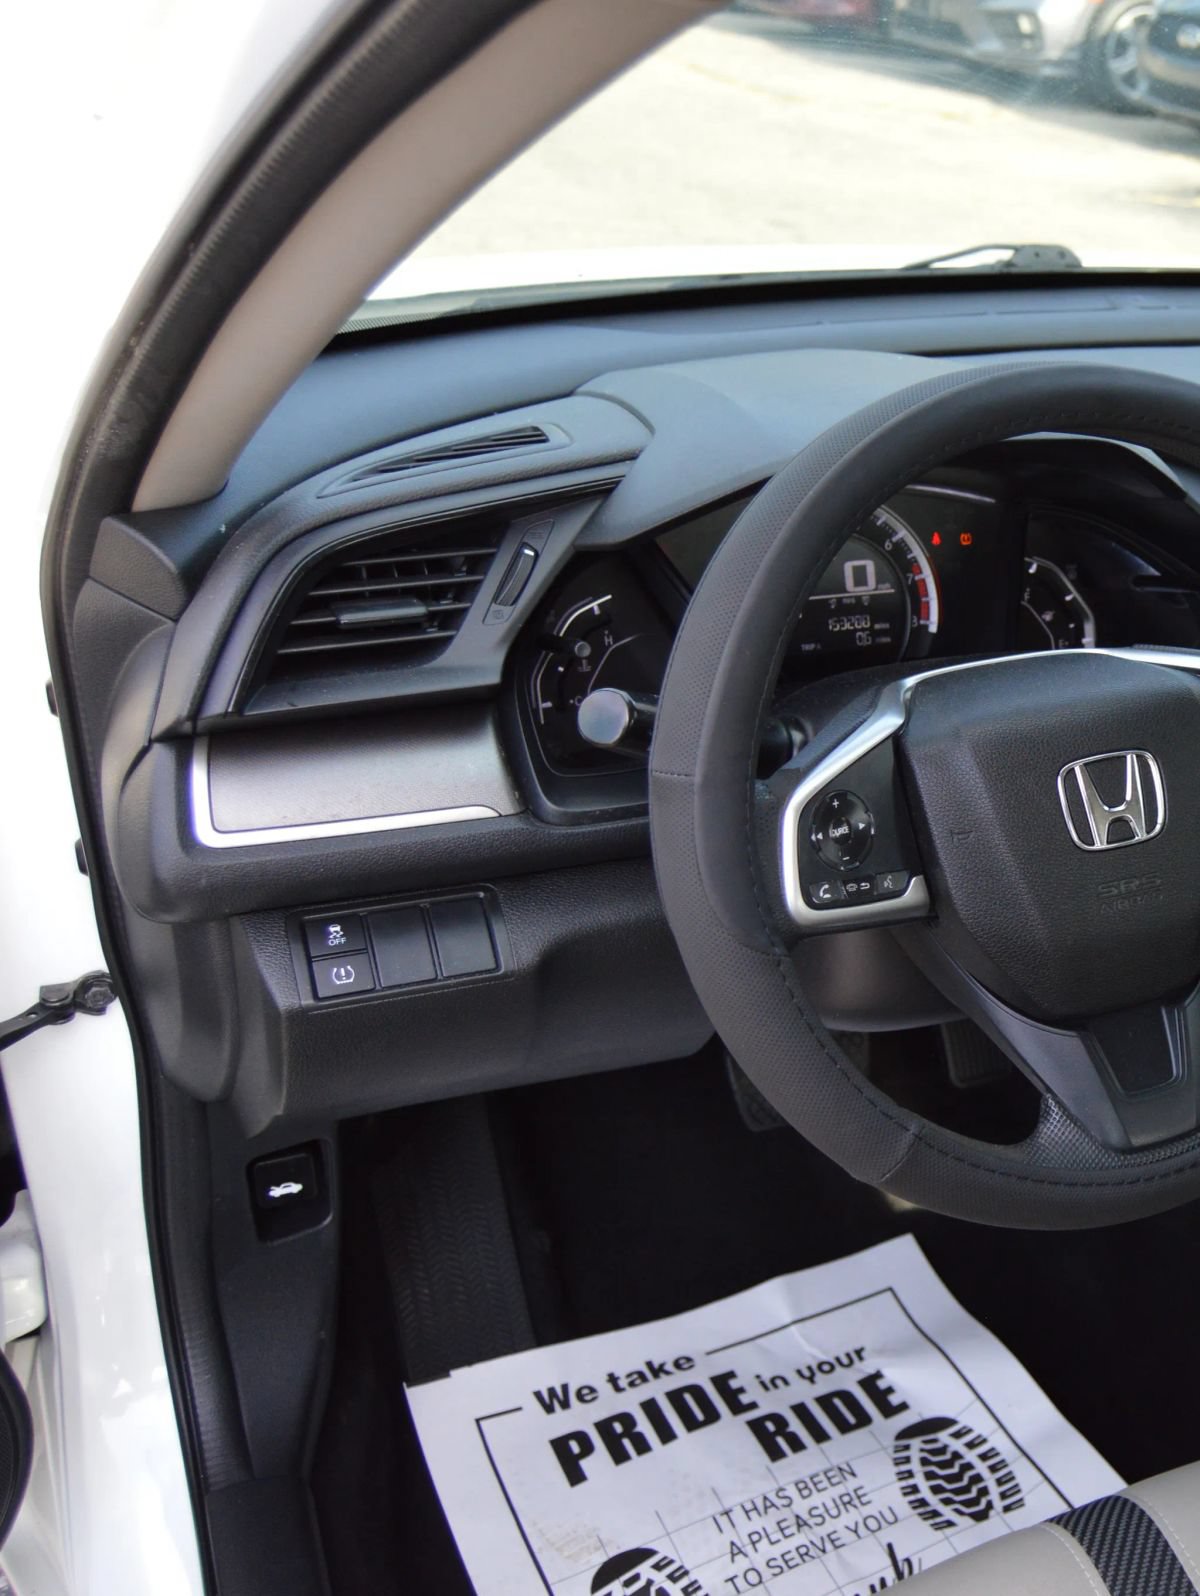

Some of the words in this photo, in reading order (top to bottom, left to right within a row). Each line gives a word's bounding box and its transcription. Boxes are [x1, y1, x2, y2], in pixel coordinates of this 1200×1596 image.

[844, 559, 876, 592] 0
[884, 540, 893, 551] 6
[328, 936, 347, 947] OFF
[532, 1382, 599, 1415] We
[606, 1354, 695, 1393] take
[549, 1370, 759, 1488] PRIDE
[755, 1373, 790, 1392] in
[795, 1347, 867, 1384] your
[745, 1370, 911, 1463] RIDE
[711, 1510, 735, 1534] IT
[740, 1487, 793, 1521] HAS
[794, 1461, 859, 1499] BEEN
[729, 1540, 749, 1563] A
[749, 1485, 873, 1552] PLEASURE
[724, 1567, 763, 1595] TO
[766, 1532, 847, 1575] SERVE
[845, 1505, 899, 1540] YOU
